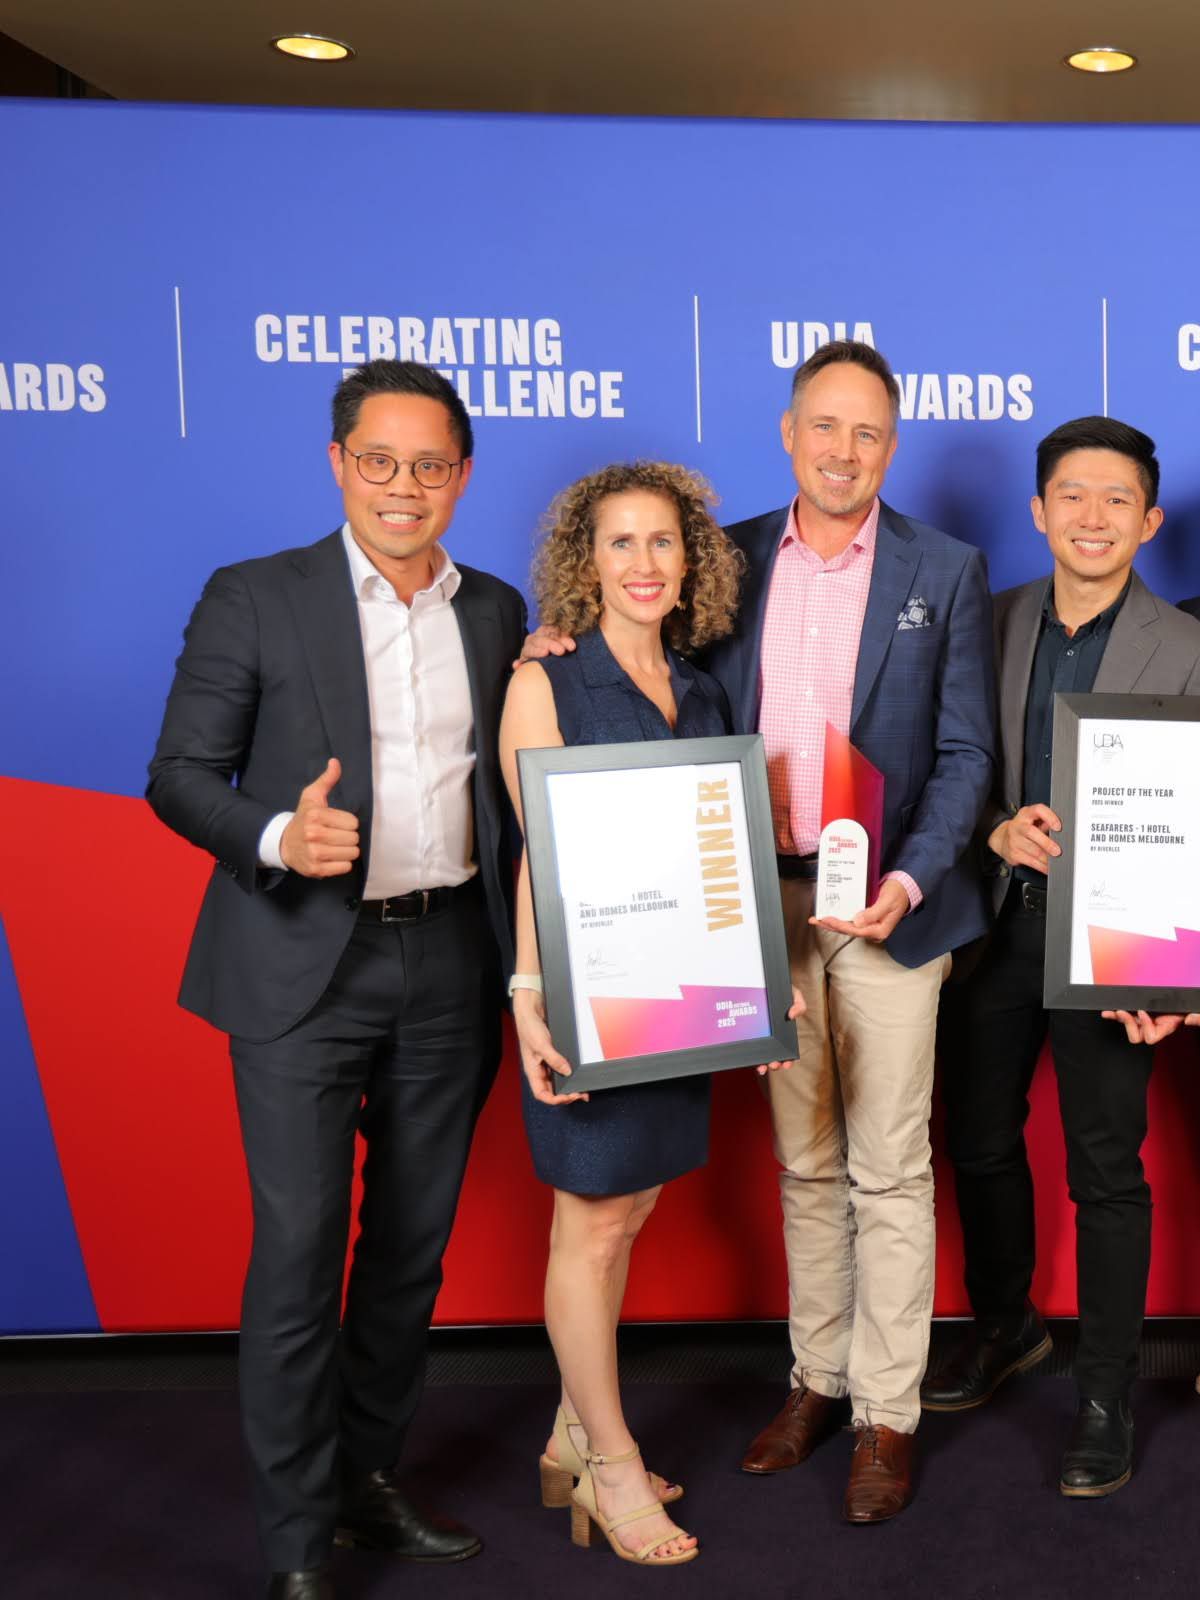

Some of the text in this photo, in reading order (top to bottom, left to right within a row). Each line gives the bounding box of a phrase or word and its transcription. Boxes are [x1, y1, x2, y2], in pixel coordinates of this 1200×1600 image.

[255, 314, 562, 366] CELEBRATING
[342, 368, 625, 418] LLENCE
[893, 373, 1034, 421] ARDS
[1092, 787, 1174, 797] PROJECT OF THE YEAR
[1091, 823, 1134, 833] SEAFARERS
[1147, 825, 1171, 834] HOTEL
[1090, 834, 1185, 845] AND HOMES MELBOURNE
[696, 778, 744, 932] WINNER
[638, 890, 663, 901] HOTEL
[600, 905, 628, 916] HOMES
[630, 899, 679, 913] MELBOURNE
